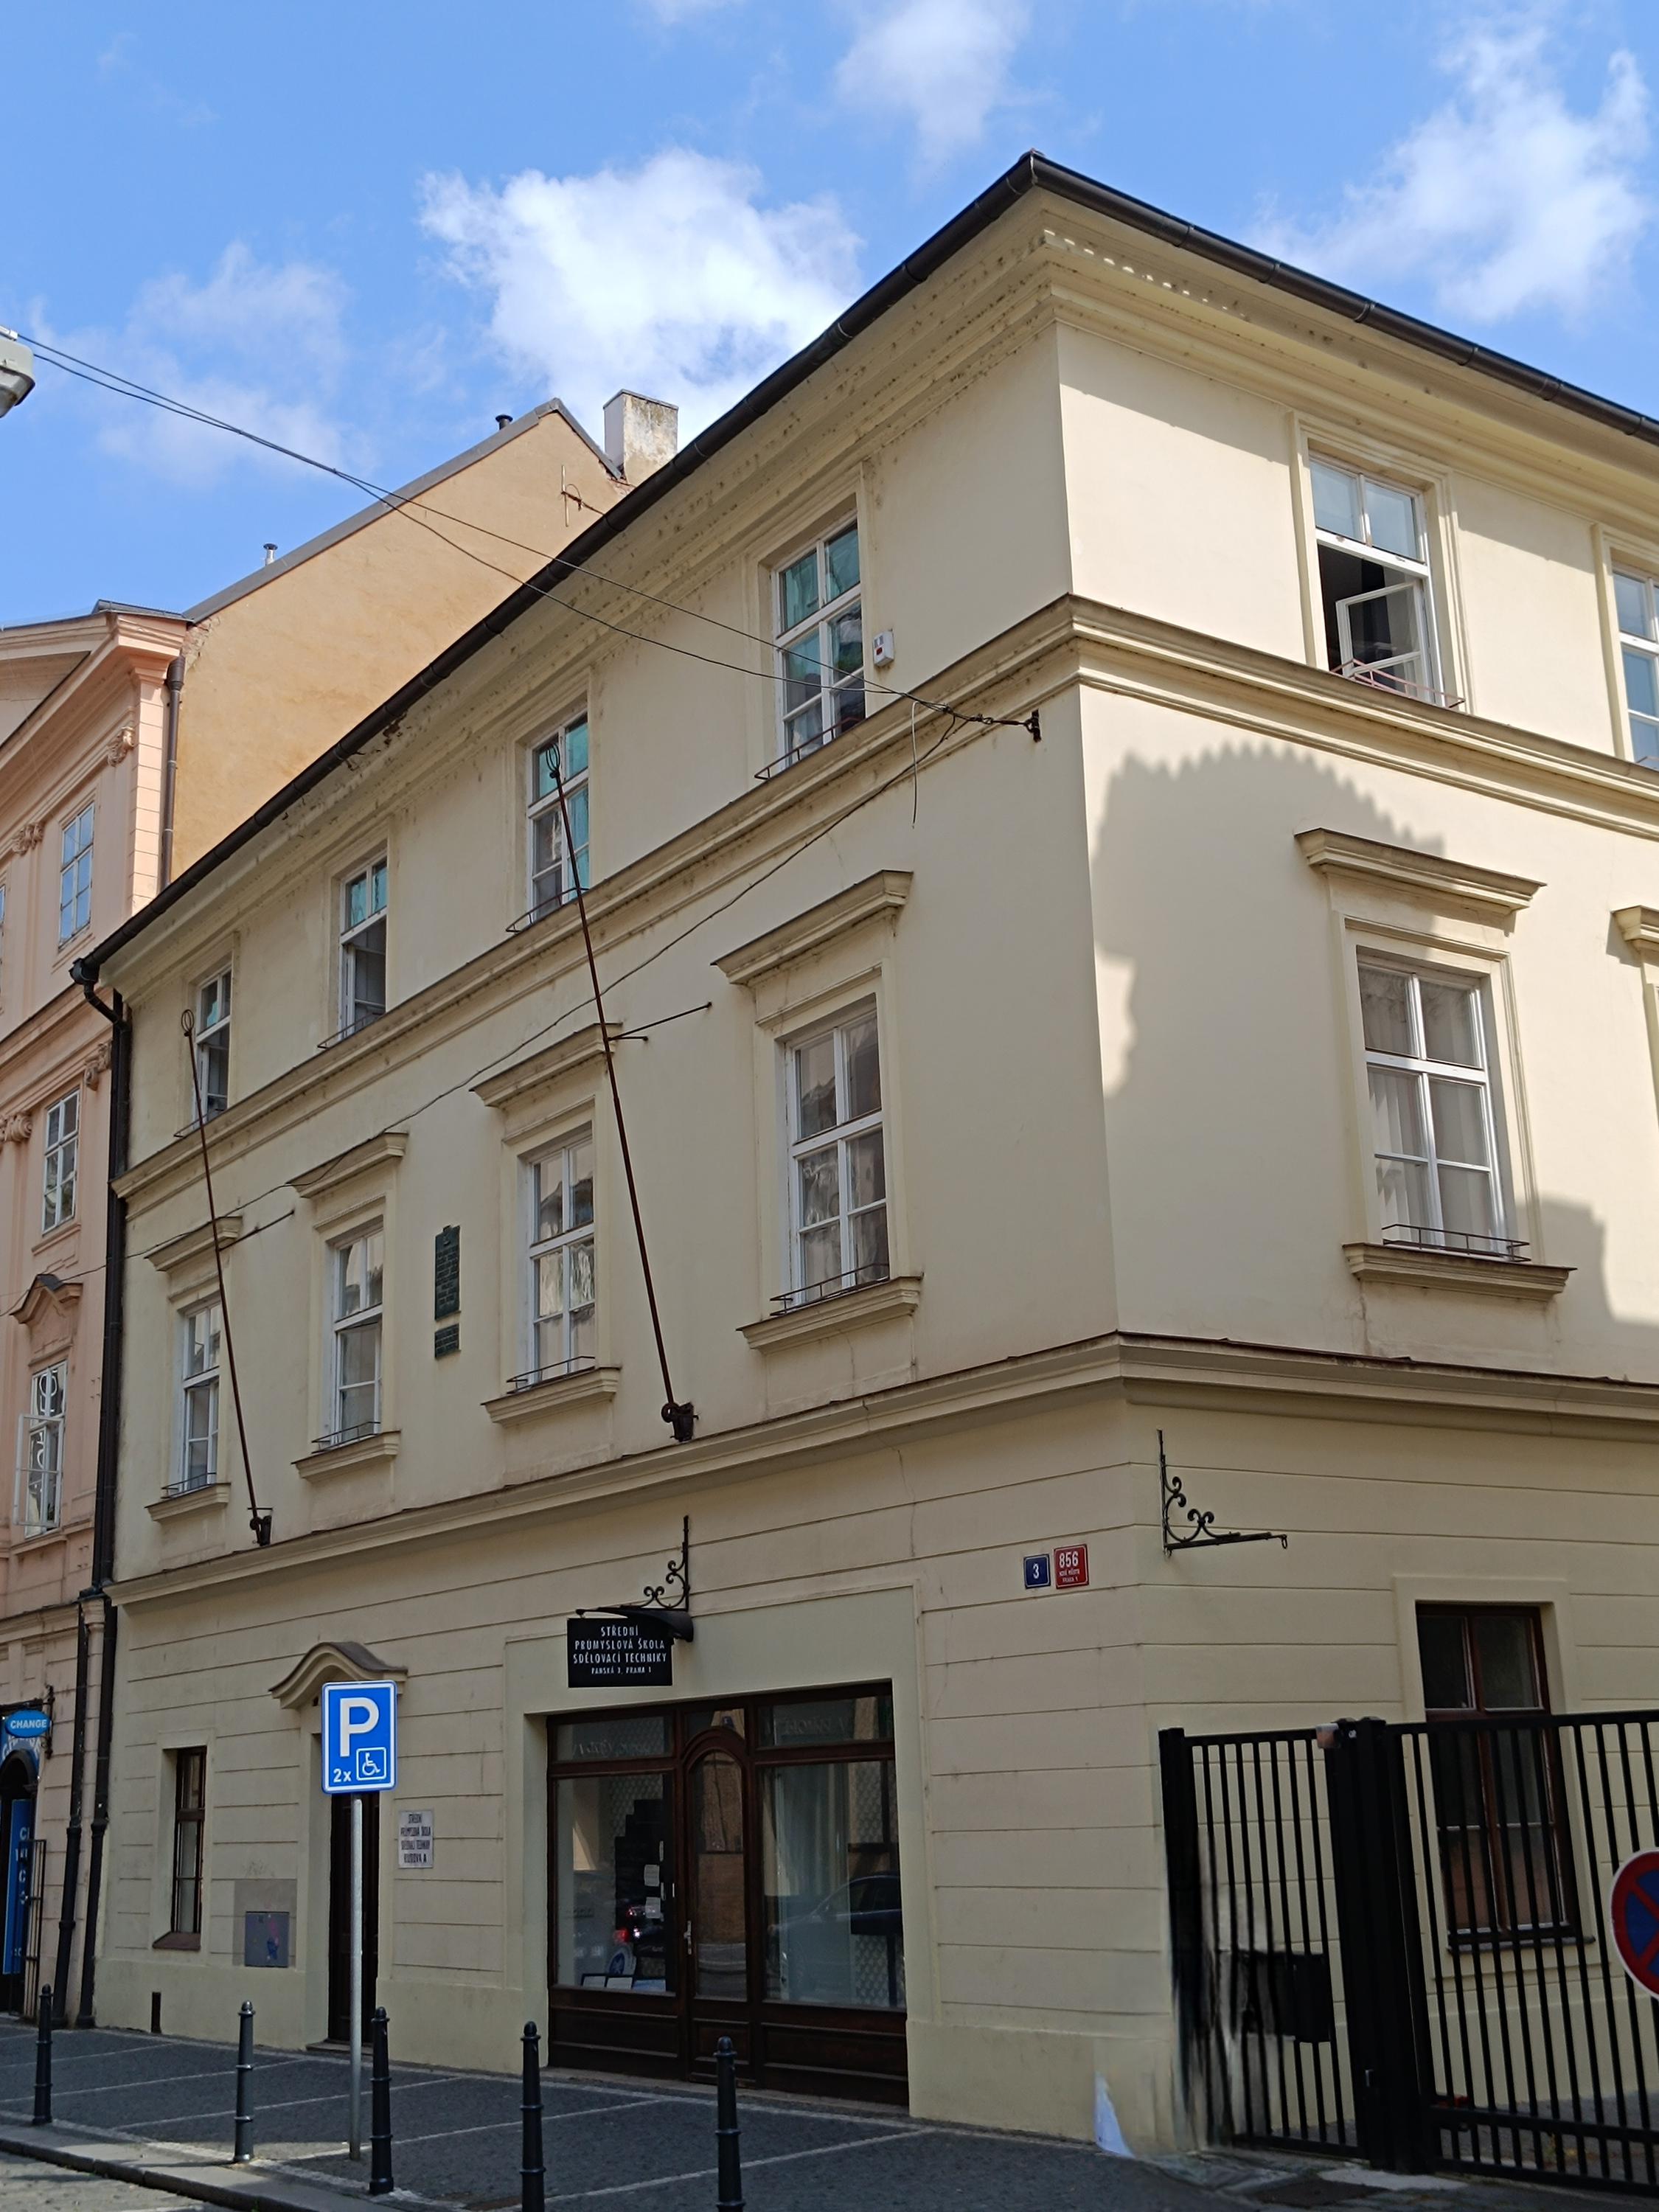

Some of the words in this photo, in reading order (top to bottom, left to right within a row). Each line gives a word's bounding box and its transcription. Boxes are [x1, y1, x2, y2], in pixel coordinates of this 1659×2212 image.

[1059, 1551, 1079, 1568] 856
[1032, 1563, 1040, 1579] 3
[600, 1624, 639, 1637] STŘEDNÍ
[574, 1638, 633, 1650] PRŮMYSLOVÁ
[638, 1638, 665, 1649] ŠKOLA
[573, 1652, 621, 1663] SDĚLOVACÍ
[625, 1652, 667, 1663] TECHNIKY
[10, 1719, 47, 1729] CHANGE
[339, 1697, 380, 1758] P
[333, 1768, 352, 1783] 2x
